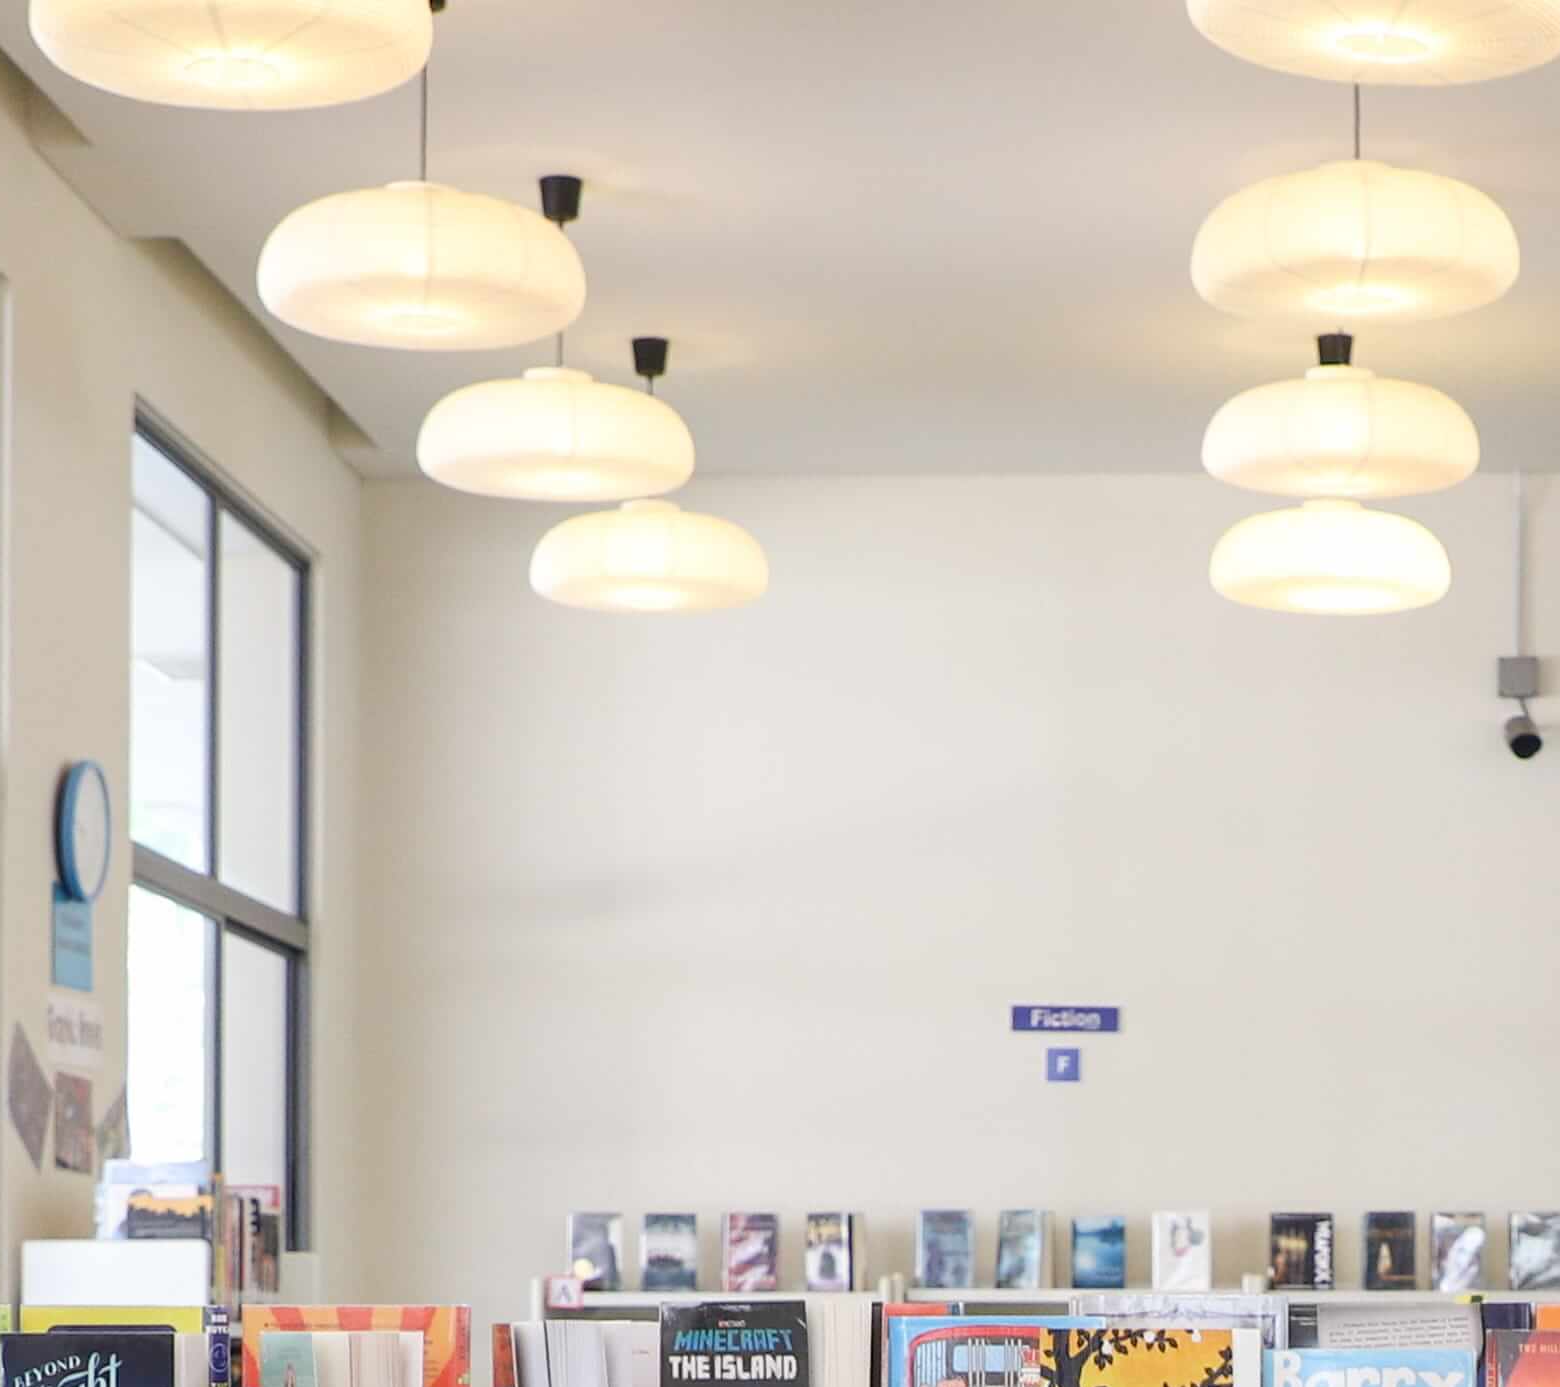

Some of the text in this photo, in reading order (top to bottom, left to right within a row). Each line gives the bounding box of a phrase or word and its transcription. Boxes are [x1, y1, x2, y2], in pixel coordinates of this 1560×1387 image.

[1030, 1009, 1100, 1030] Fiction
[1057, 1056, 1071, 1073] F
[674, 1328, 794, 1353] MINECRAFT
[669, 1354, 798, 1381] THE ISLAND
